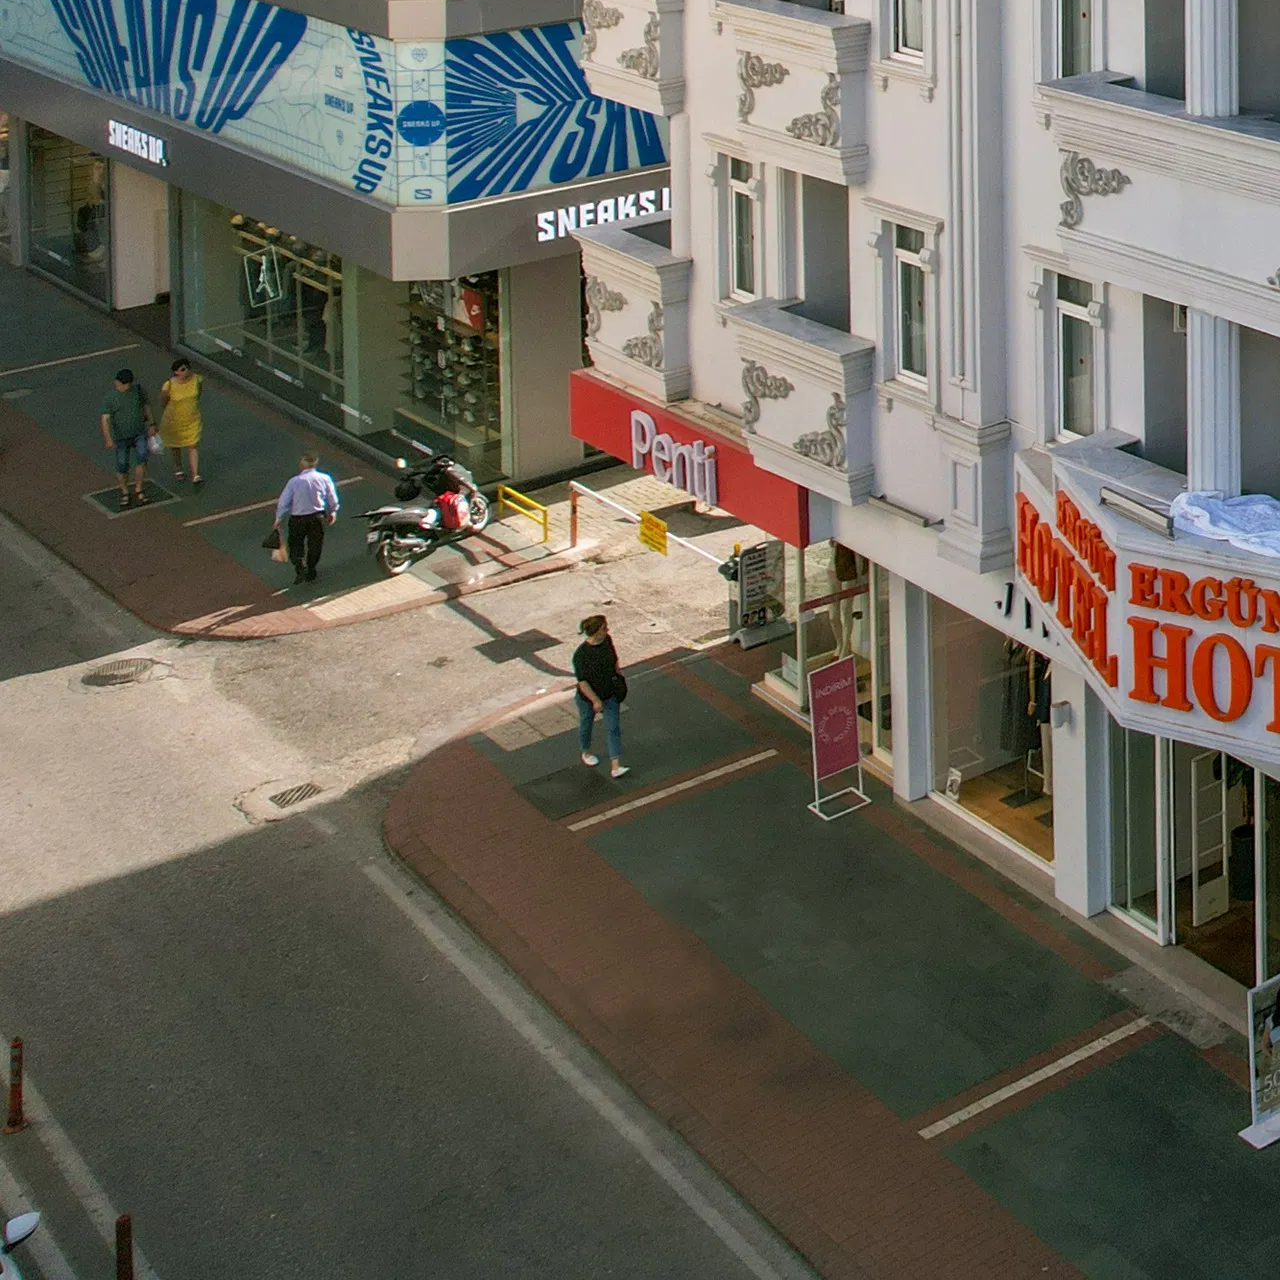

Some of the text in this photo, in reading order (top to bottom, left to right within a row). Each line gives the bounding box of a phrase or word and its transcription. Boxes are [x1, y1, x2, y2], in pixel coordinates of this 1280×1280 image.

[109, 119, 148, 160] SNEAKS
[537, 190, 656, 242] SNEAKS
[631, 410, 717, 506] Penti
[1056, 489, 1116, 592] ERGÜN
[1015, 491, 1118, 688] HOTEL
